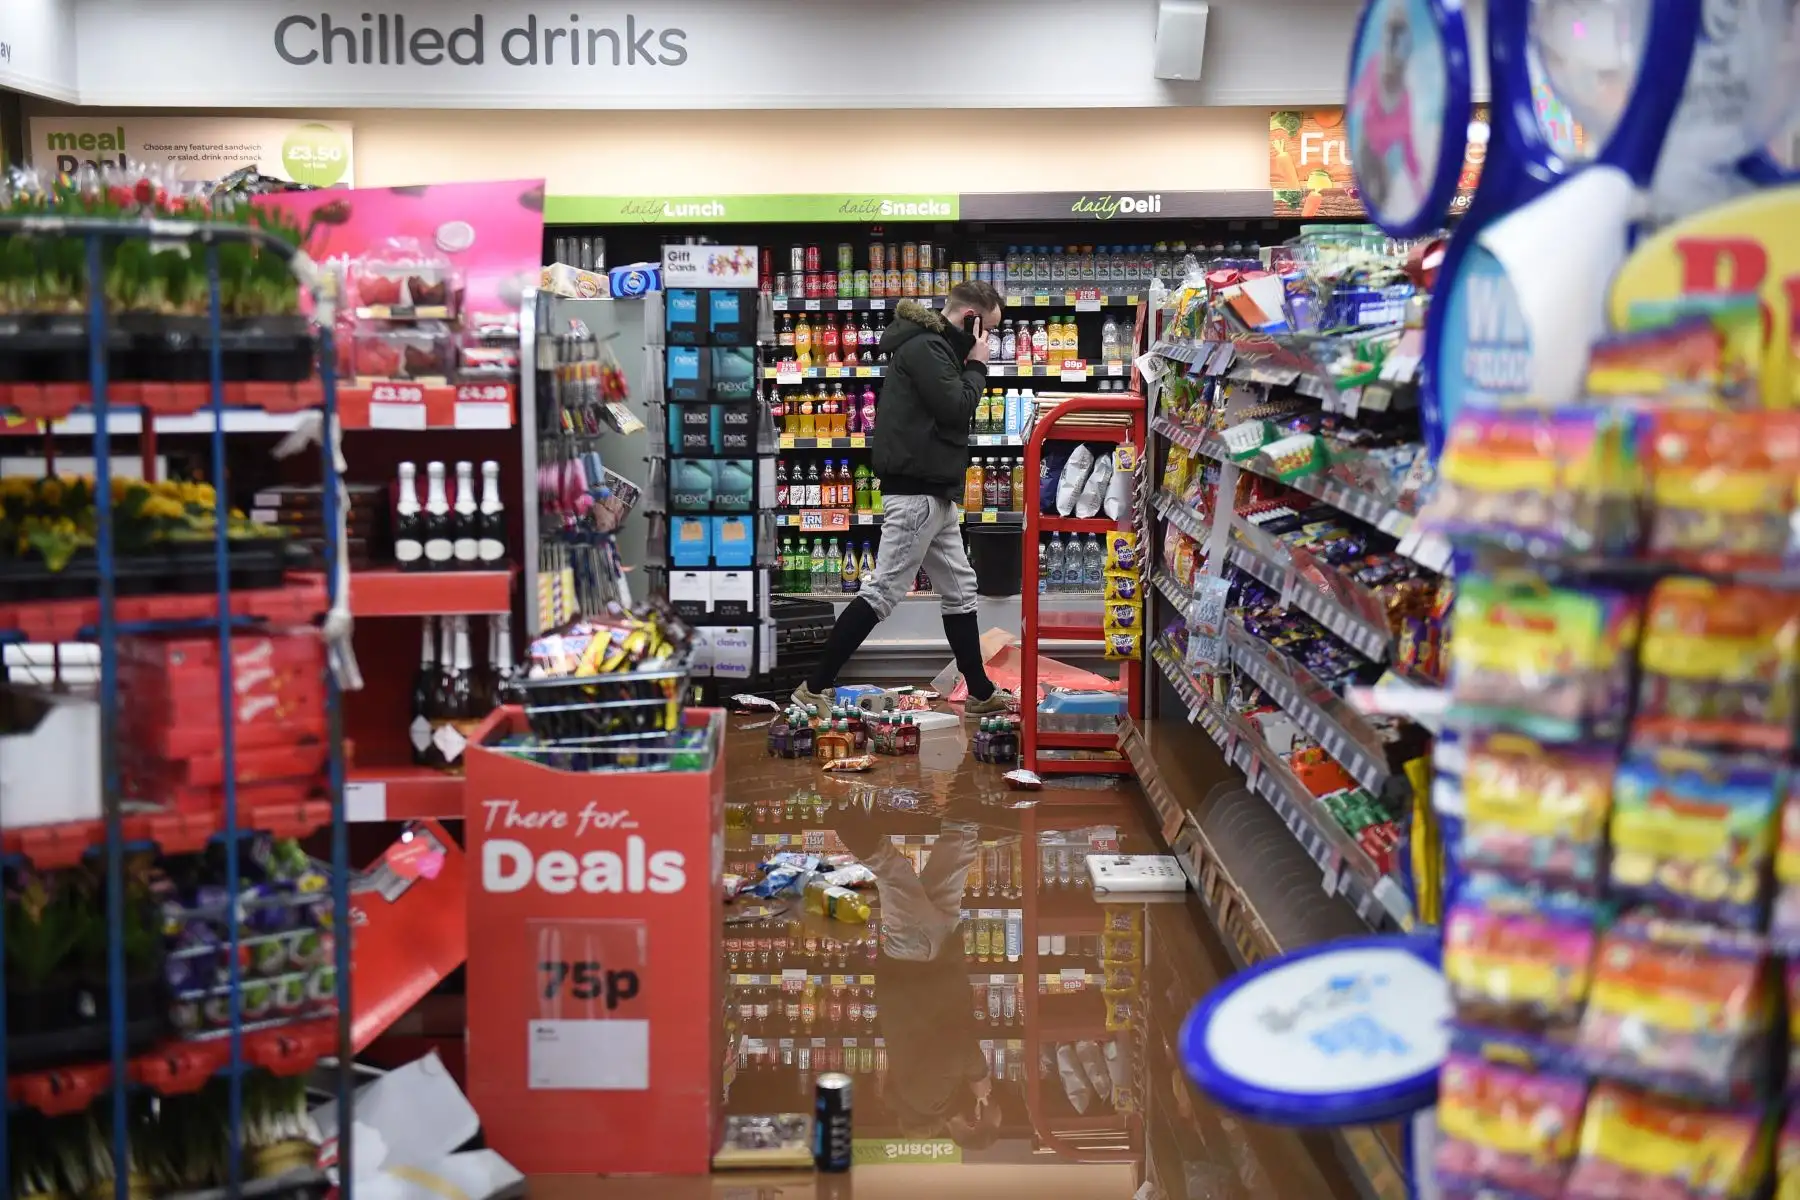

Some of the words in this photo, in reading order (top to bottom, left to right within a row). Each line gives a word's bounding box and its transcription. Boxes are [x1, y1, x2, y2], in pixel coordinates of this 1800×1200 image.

[274, 13, 484, 66] Chilled
[501, 13, 689, 66] drinks
[0, 41, 11, 63] ay
[47, 126, 125, 151] meal
[143, 143, 172, 151] Choose
[174, 144, 188, 152] any
[189, 143, 223, 151] featured
[224, 143, 262, 151] sandwich
[1299, 131, 1354, 166] Fru
[287, 145, 341, 161] £3.50
[620, 198, 665, 225] daily
[664, 199, 725, 217] Lunch
[839, 198, 884, 225] daily
[880, 199, 951, 217] Snacks
[1071, 196, 1123, 220] daily
[1120, 194, 1161, 214] Deli
[667, 251, 691, 263] Gift
[667, 263, 697, 272] Cards
[1064, 360, 1082, 369] 69p
[717, 380, 750, 392] next
[1007, 399, 1017, 430] WATER
[674, 493, 706, 504] next
[715, 493, 748, 504] next
[802, 515, 822, 524] IRN
[832, 517, 844, 525] £2
[481, 799, 569, 833] There
[481, 835, 687, 894] Deals
[538, 960, 640, 1011] 75p
